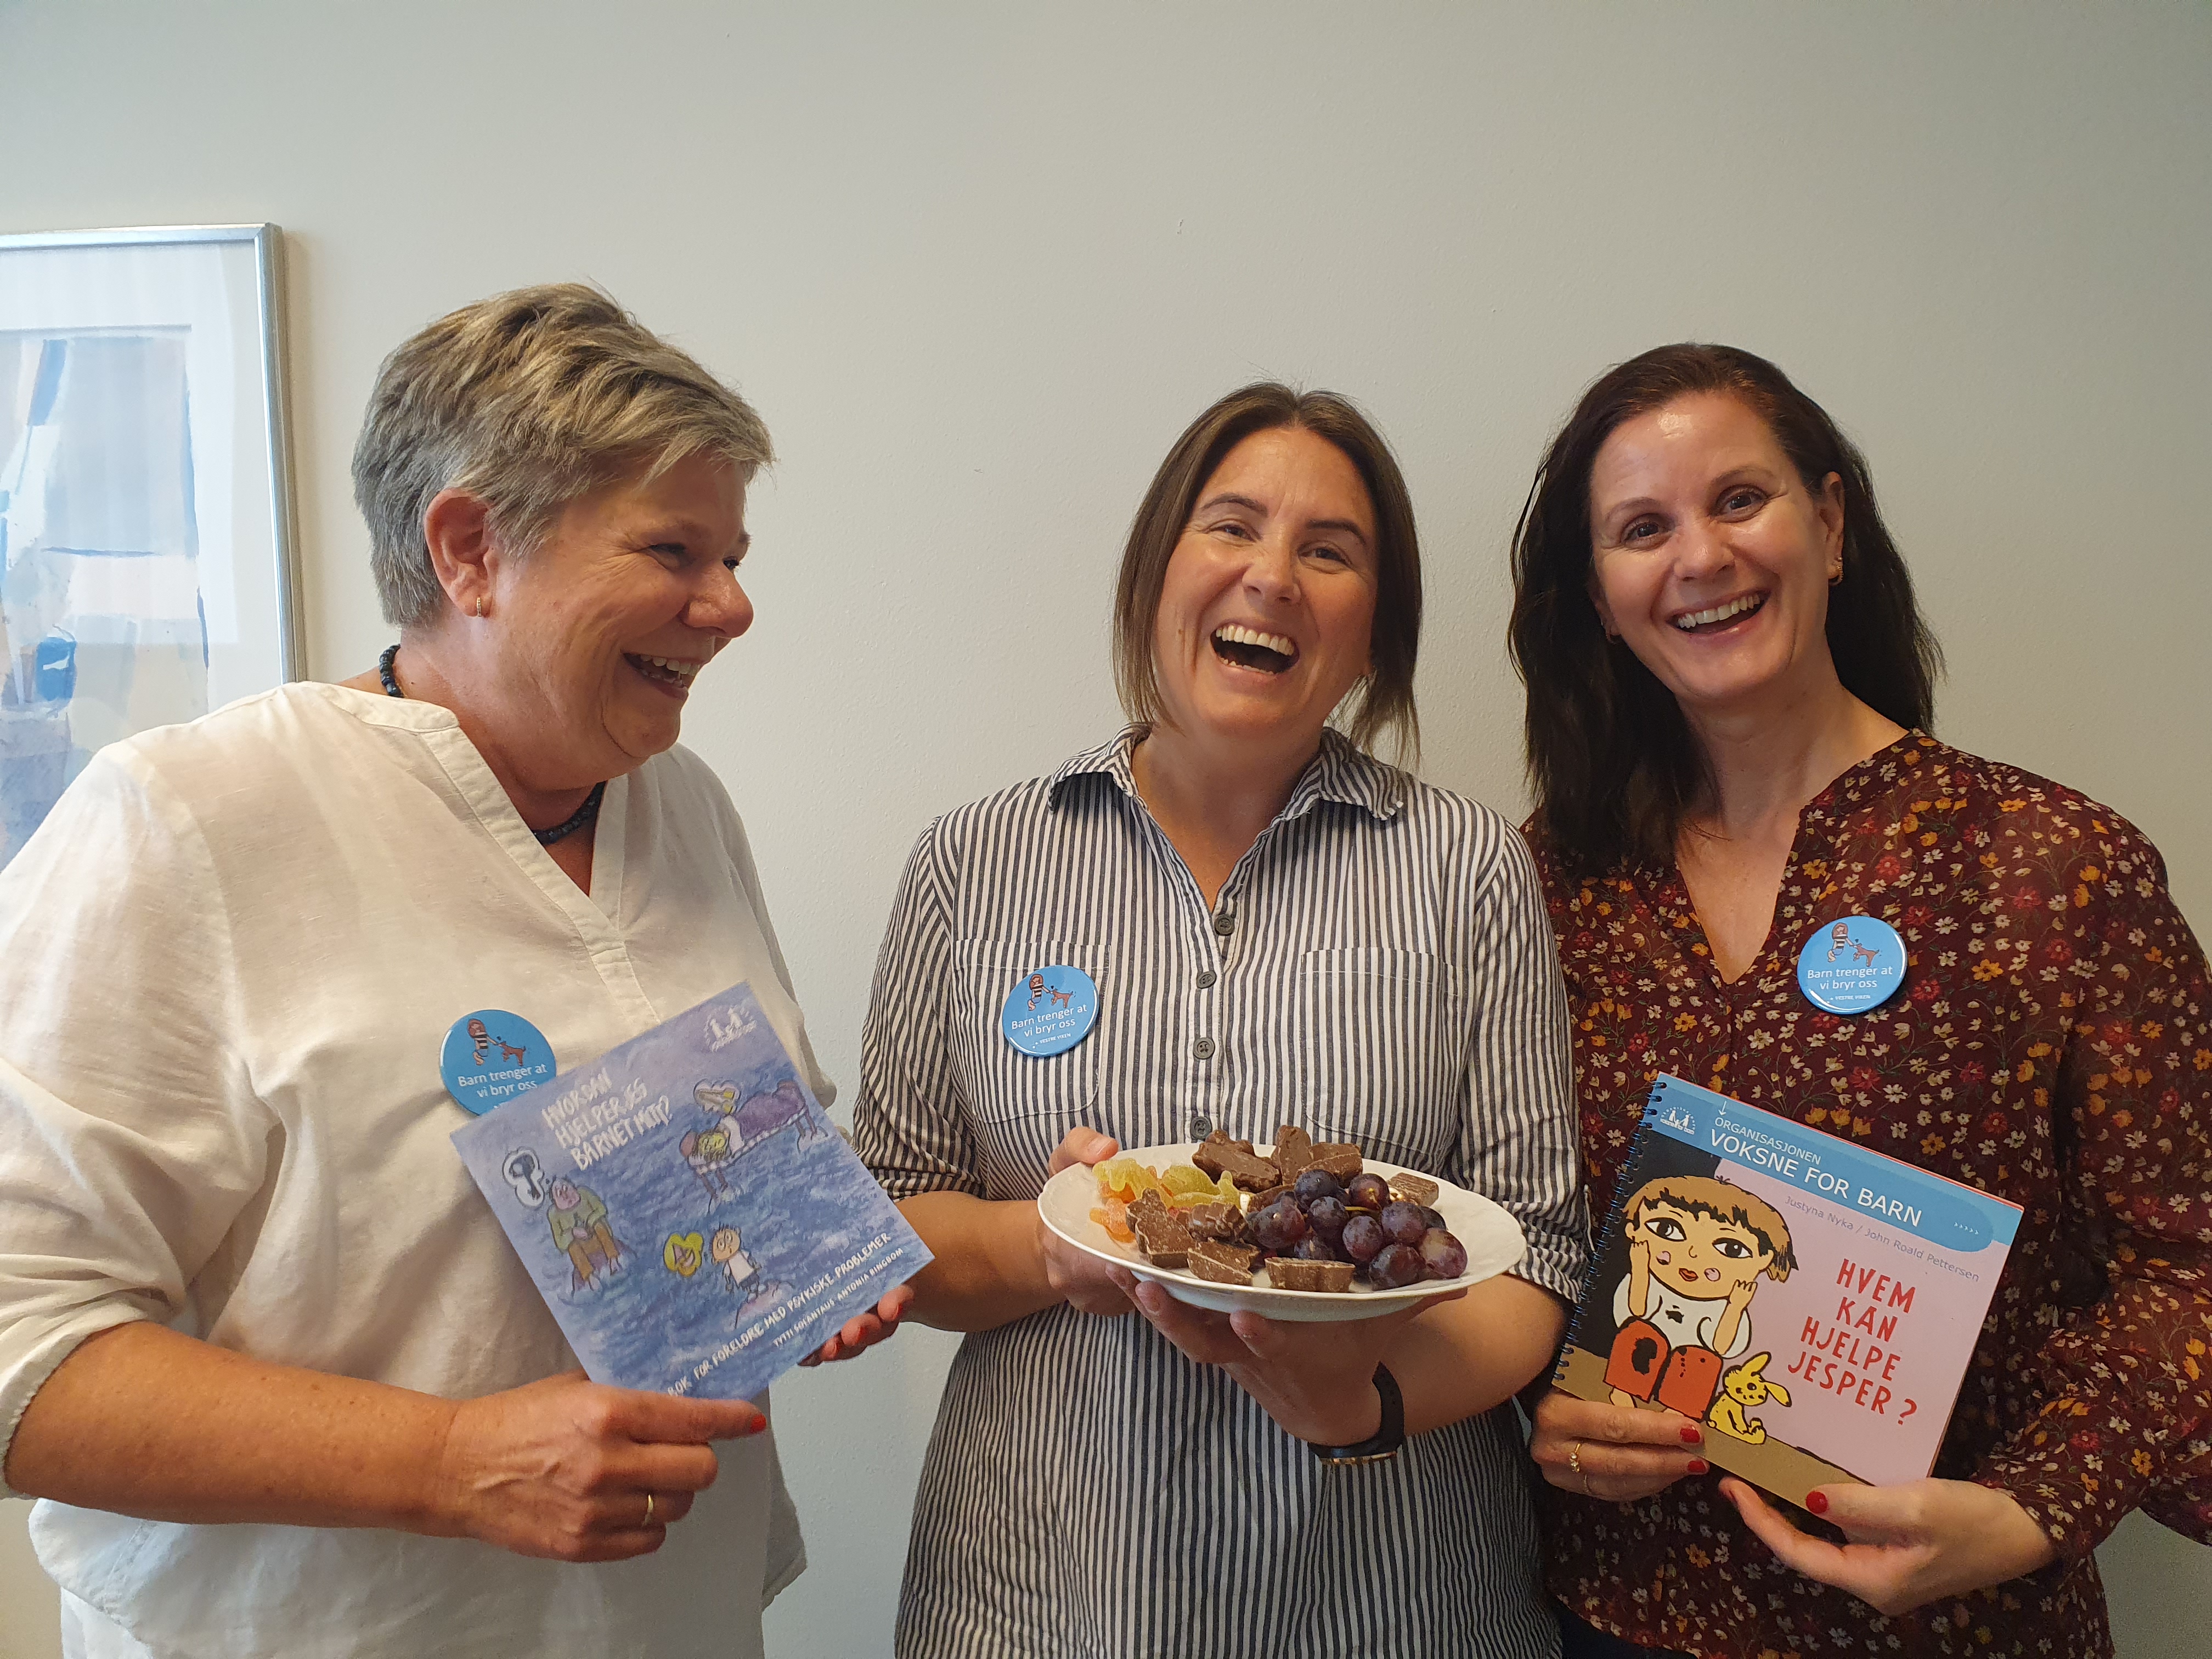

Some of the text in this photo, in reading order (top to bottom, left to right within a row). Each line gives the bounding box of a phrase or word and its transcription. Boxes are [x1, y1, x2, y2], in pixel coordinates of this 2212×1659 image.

[1808, 966, 1893, 979] Barn trenger at
[1820, 980, 1877, 991] vi bryr oss
[1012, 1004, 1087, 1030] Barn trenger at
[1024, 1019, 1076, 1037] vi bryr oss
[458, 1064, 548, 1087] Barn trenger at
[476, 1080, 538, 1098] vi bryr oss
[570, 1118, 635, 1171] BARNET
[1714, 1116, 1821, 1165] ORGANISASJONEN
[1711, 1128, 1922, 1228] VOKSNE FOR BARN
[1785, 1195, 1824, 1219] Justyna
[1827, 1212, 1854, 1231] Nyka
[1865, 1228, 1891, 1245] John
[1894, 1239, 1925, 1260] Roald
[1927, 1252, 1980, 1282] Pettersen
[693, 1358, 714, 1380] FOR
[712, 1322, 765, 1367] FORELDRE
[763, 1306, 787, 1329] MED
[834, 1232, 891, 1279] PROBLEMER
[837, 1273, 870, 1301] ANTONIA
[1836, 1258, 1916, 1313] HVEM
[1836, 1296, 1898, 1342] KAN
[1801, 1316, 1900, 1381] HJELPE
[1788, 1351, 1917, 1425] JESPER ?
